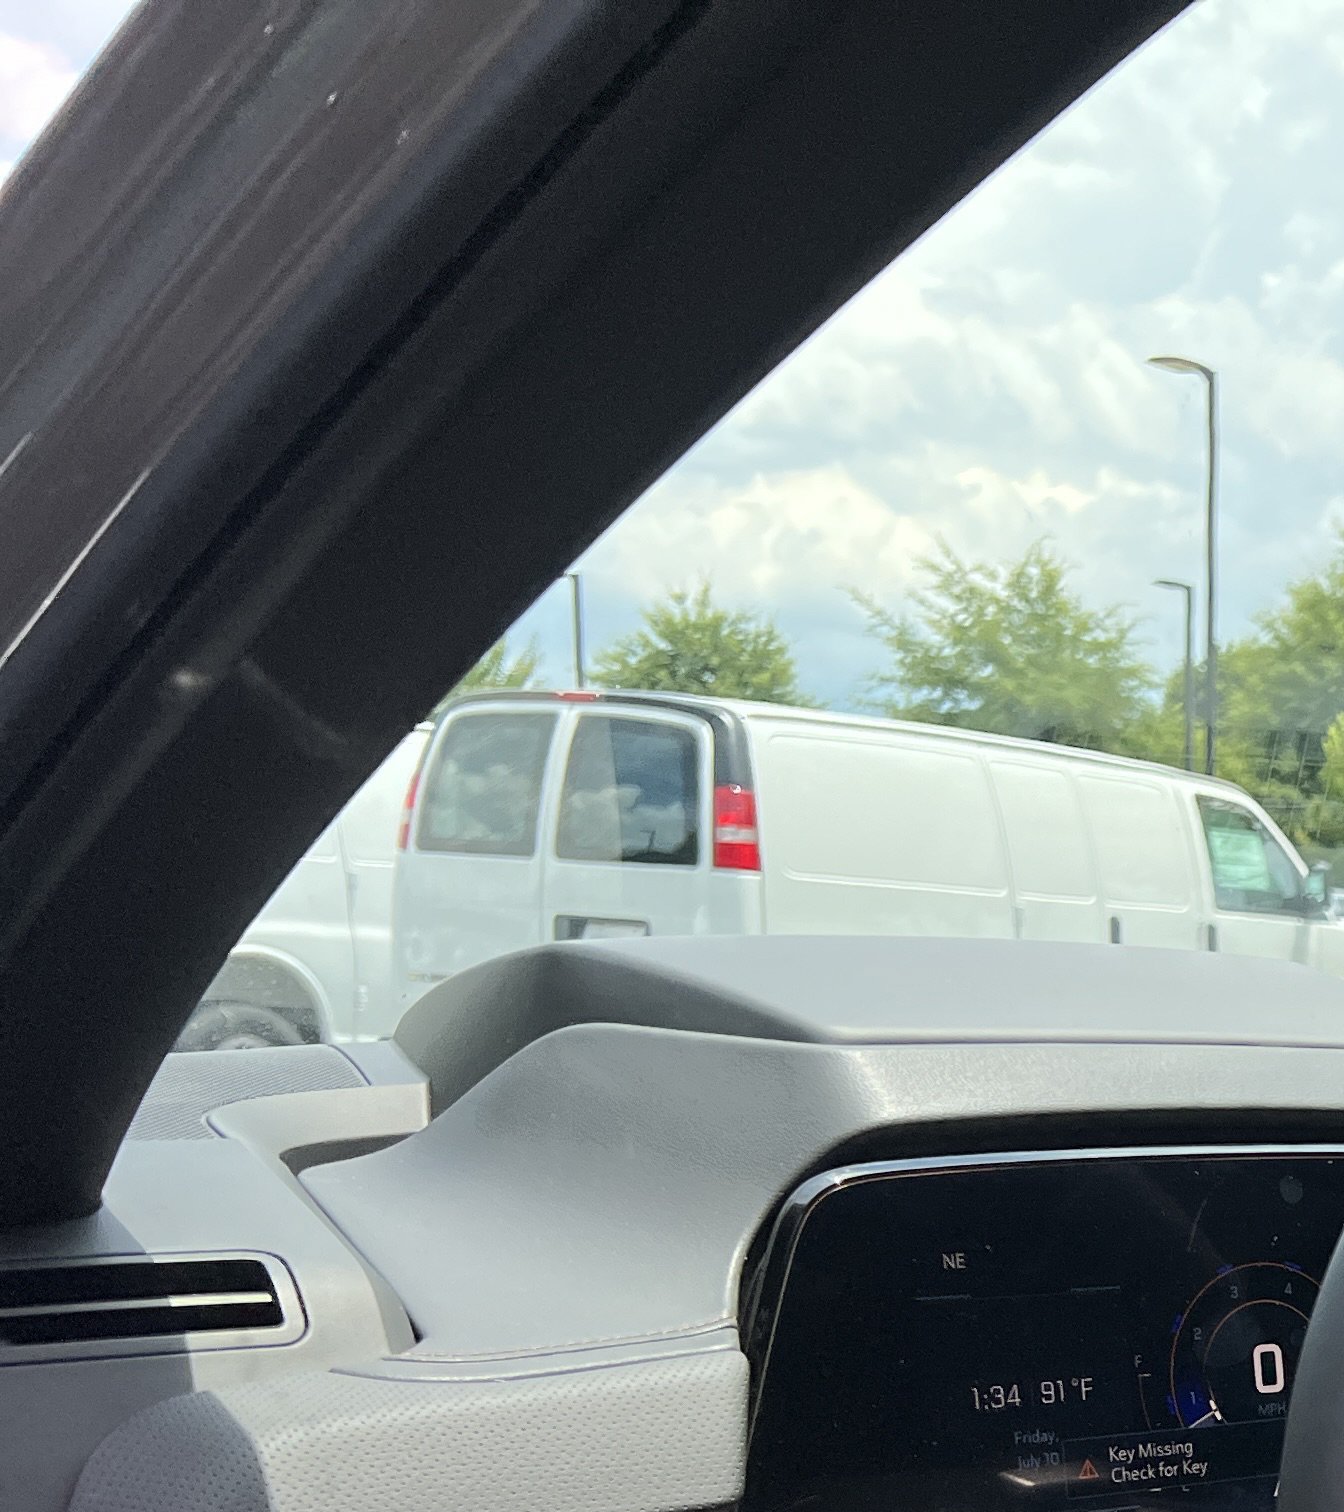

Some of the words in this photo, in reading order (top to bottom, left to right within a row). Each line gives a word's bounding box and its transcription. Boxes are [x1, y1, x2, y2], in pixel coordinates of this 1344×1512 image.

[942, 1252, 967, 1270] NE
[1253, 1343, 1285, 1394] 0
[971, 1384, 1022, 1410] 1:34
[1257, 1401, 1287, 1417] MPH
[1109, 1445, 1135, 1463] Key
[1138, 1441, 1193, 1459] Missing
[1111, 1464, 1156, 1483] Check
[1158, 1462, 1178, 1477] for
[1182, 1459, 1208, 1477] Key
